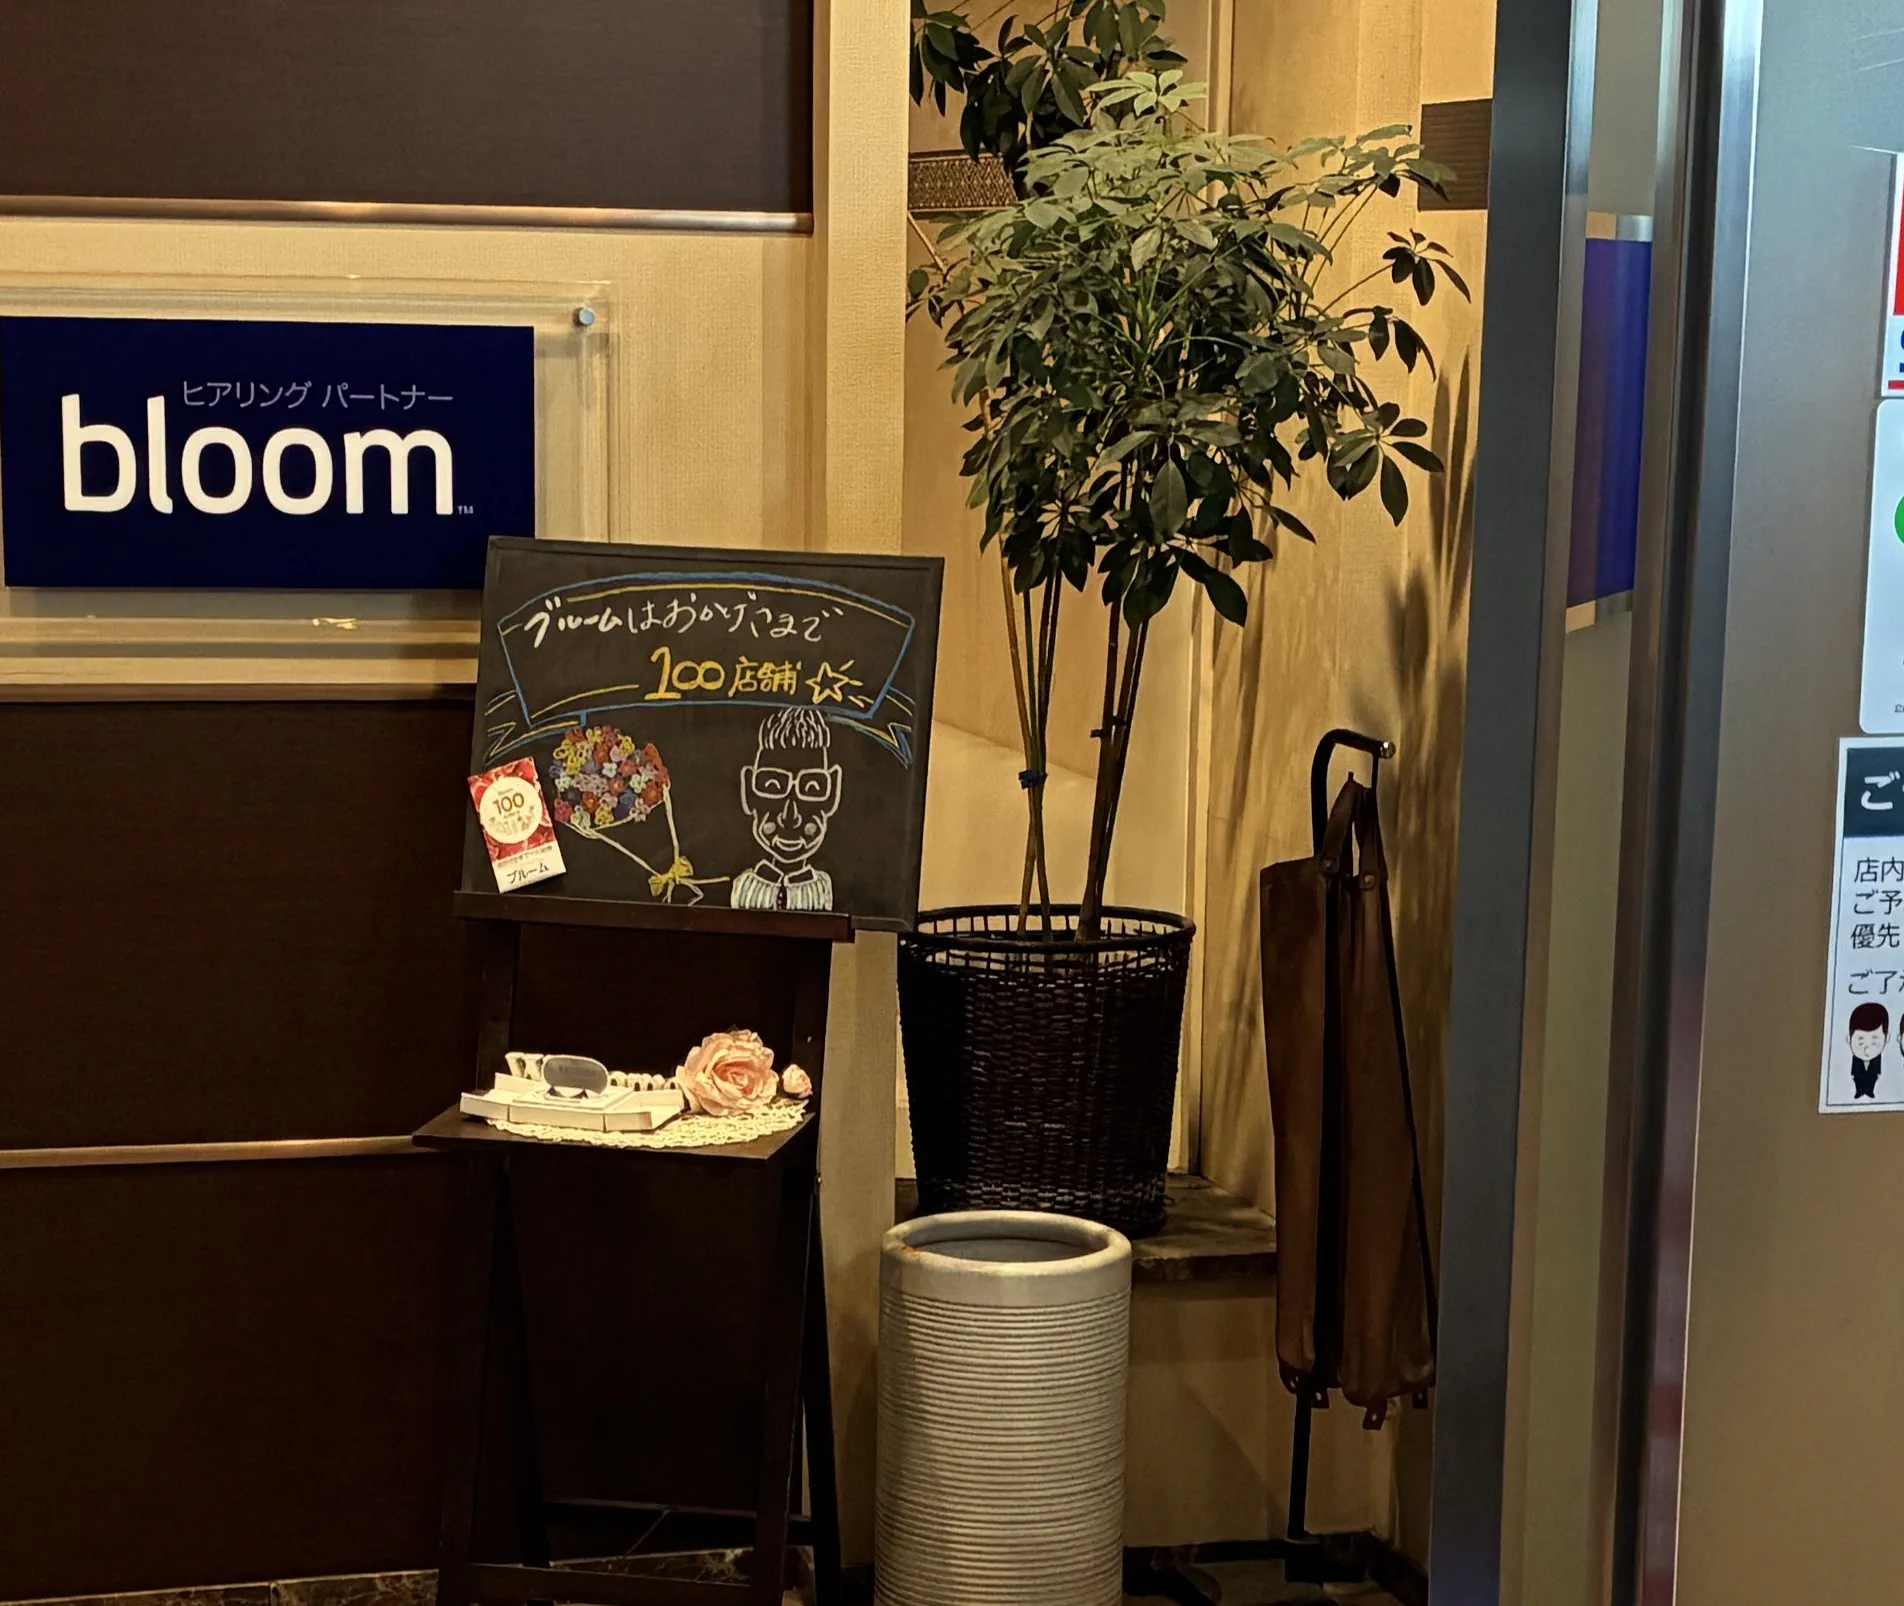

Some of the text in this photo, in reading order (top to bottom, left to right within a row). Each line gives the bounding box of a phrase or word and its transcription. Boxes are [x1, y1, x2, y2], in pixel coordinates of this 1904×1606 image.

[183, 380, 454, 411] ヒアリング パートナー
[61, 393, 454, 515] bloom
[643, 645, 803, 700] 100店舗
[492, 791, 525, 815] 100
